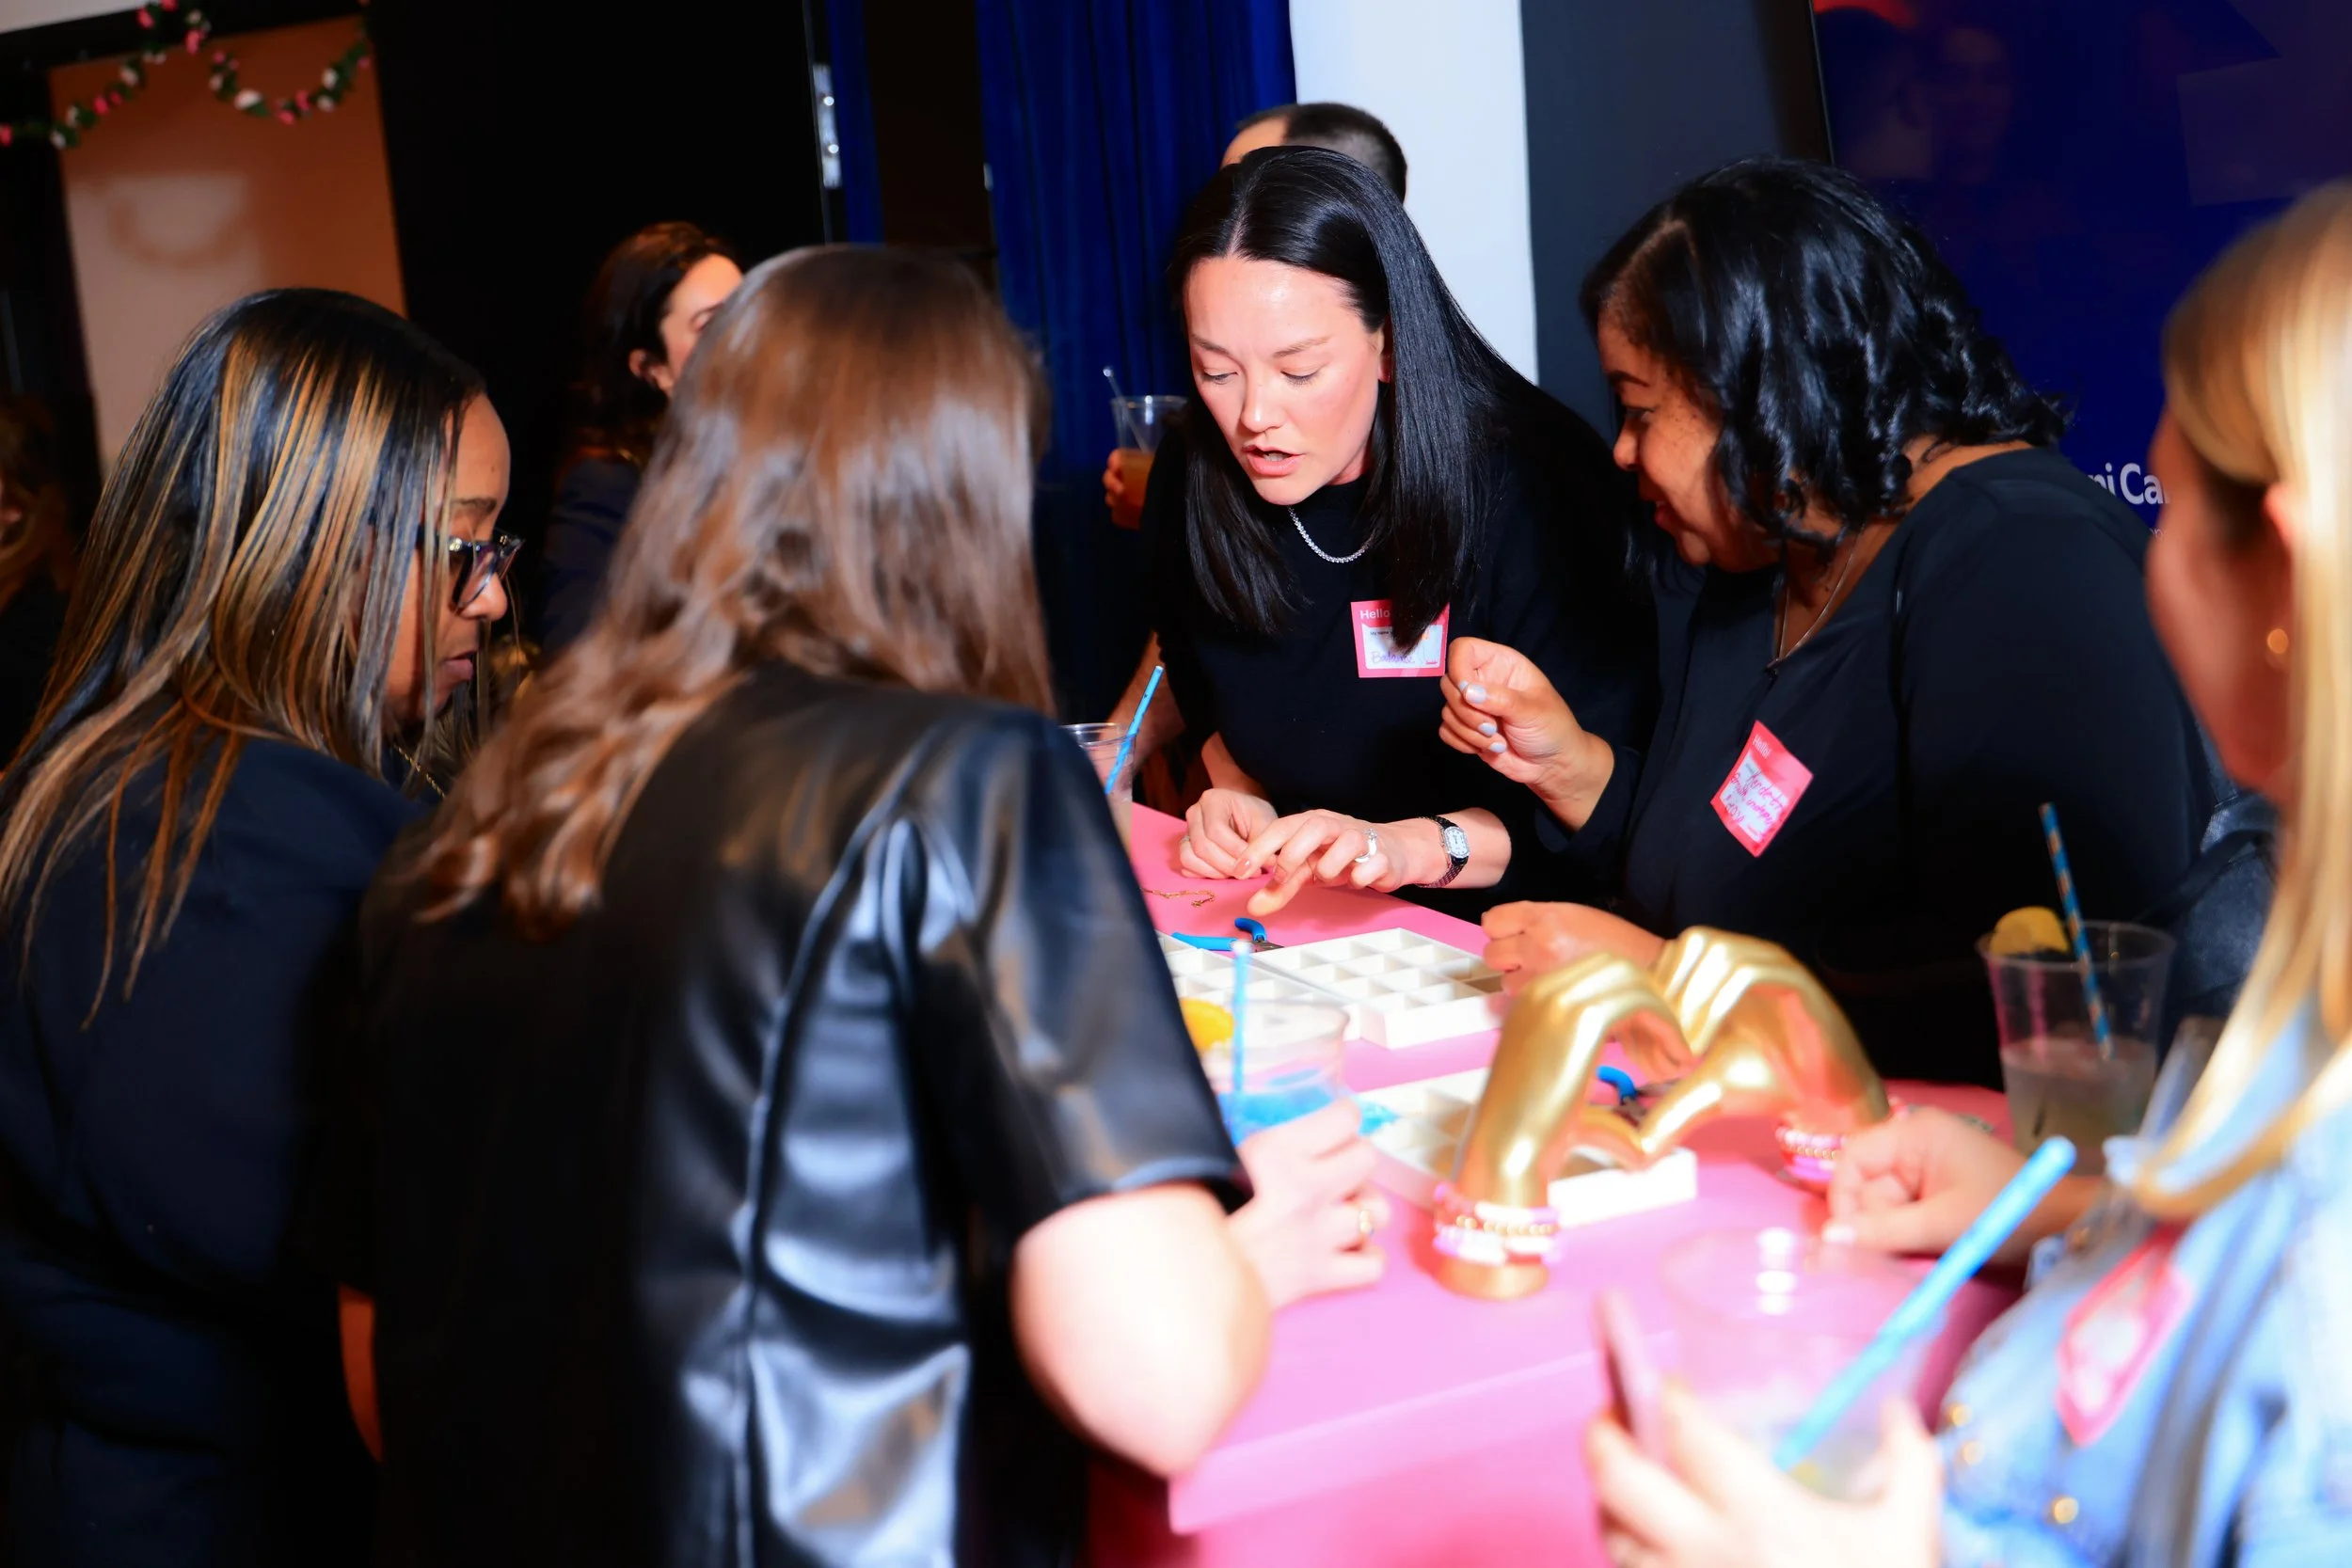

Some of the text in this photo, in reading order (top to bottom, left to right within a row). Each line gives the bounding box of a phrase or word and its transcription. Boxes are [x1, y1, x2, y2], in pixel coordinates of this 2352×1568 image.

[2120, 462, 2170, 505] Ca
[1359, 609, 1391, 620] Hello
[1752, 734, 1772, 759] Hello!
